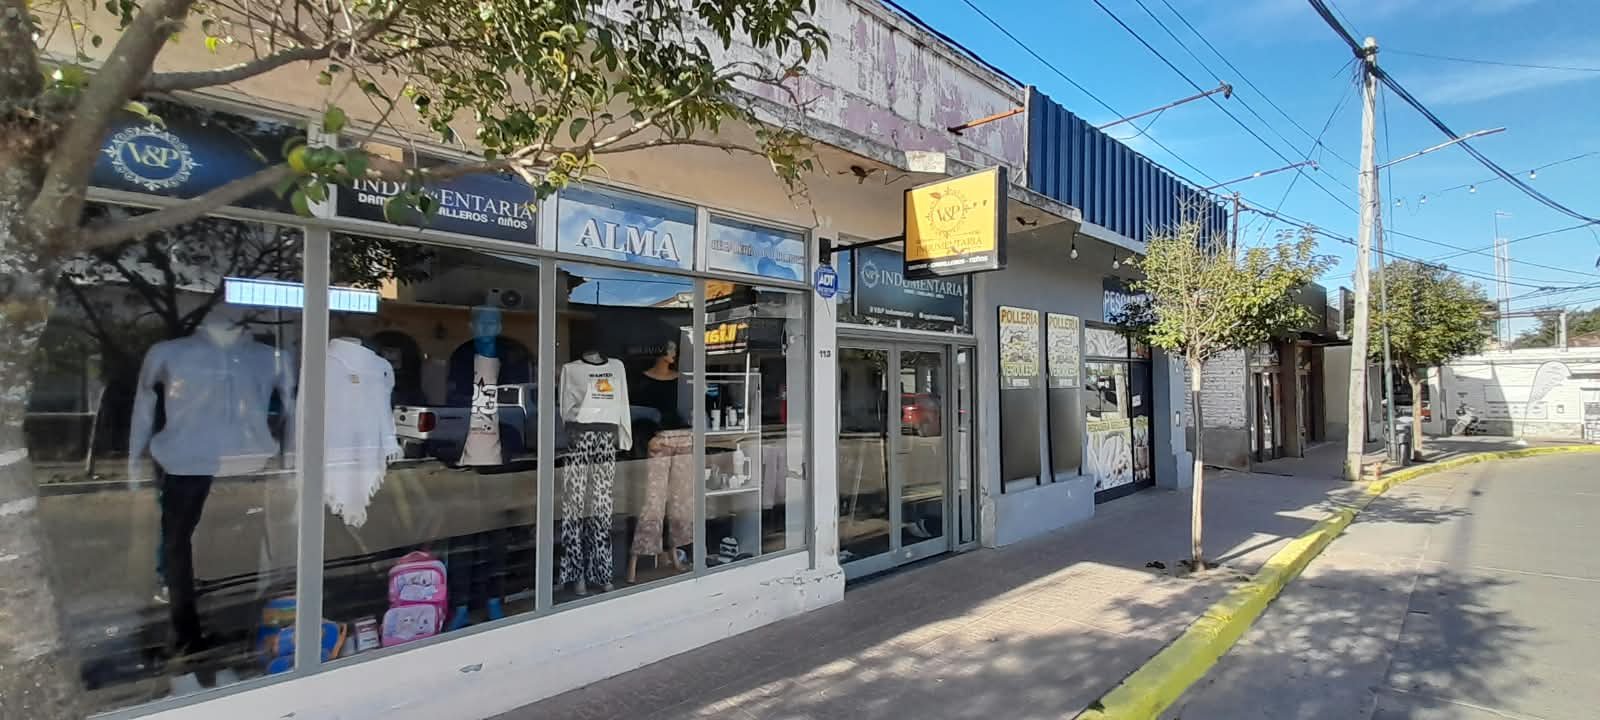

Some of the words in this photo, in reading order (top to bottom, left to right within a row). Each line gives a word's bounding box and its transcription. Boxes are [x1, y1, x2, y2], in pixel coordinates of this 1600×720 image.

[353, 178, 533, 220] INDENTARIA
[358, 193, 386, 206] DAM
[576, 218, 680, 261] ALMA
[818, 274, 835, 287] ADT
[881, 269, 963, 296] INDUMENTARIA
[819, 350, 831, 358] 113
